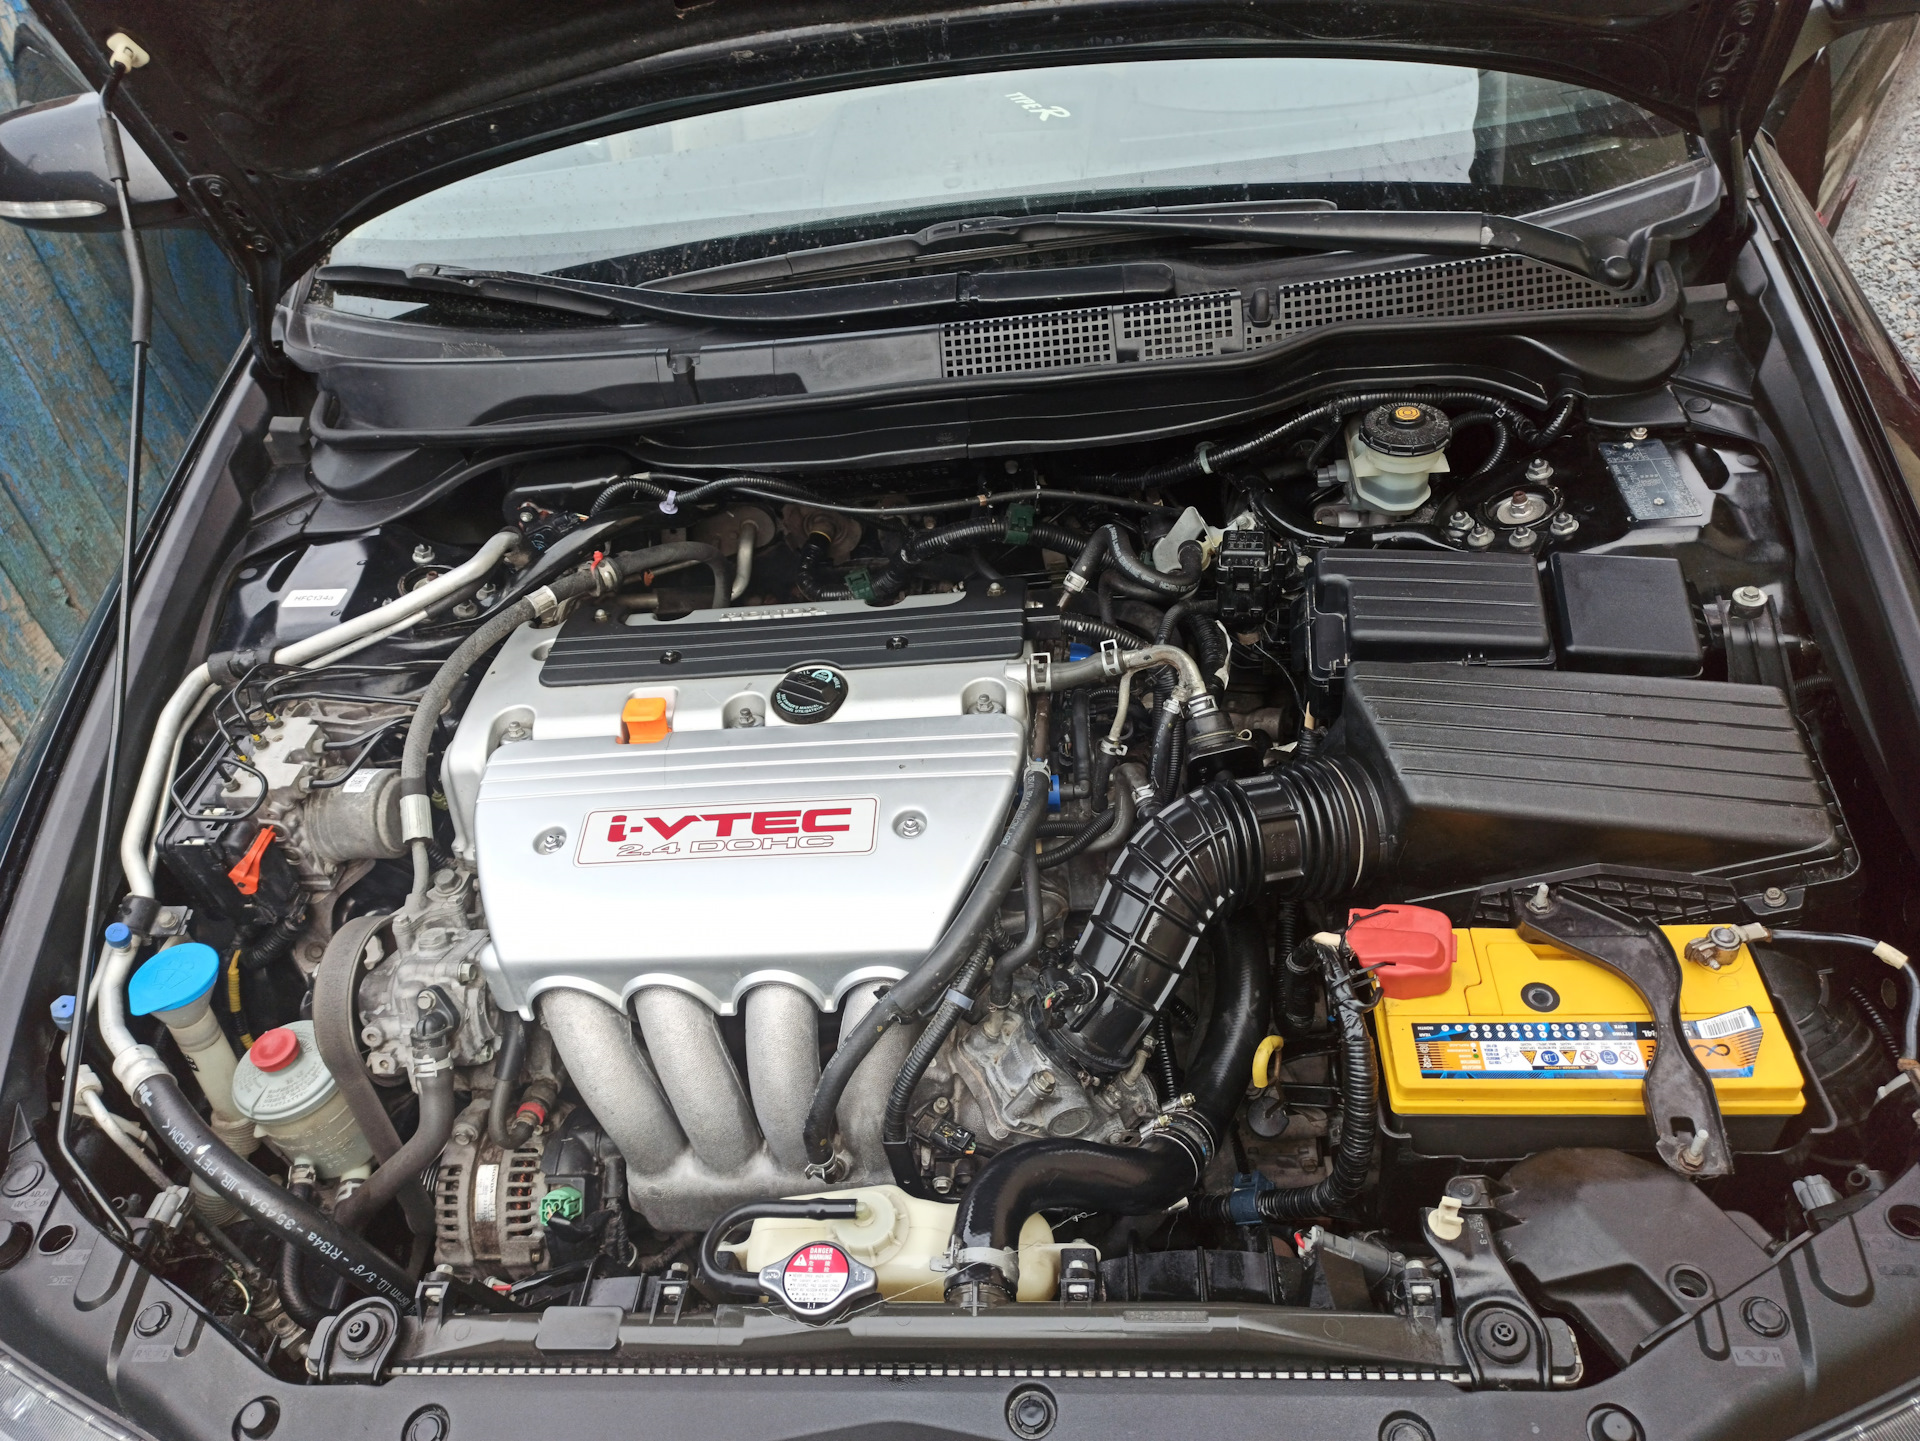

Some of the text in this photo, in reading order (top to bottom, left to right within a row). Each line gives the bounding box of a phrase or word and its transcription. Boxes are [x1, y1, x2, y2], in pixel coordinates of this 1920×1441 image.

[607, 807, 852, 843] i-VTEC
[616, 835, 835, 857] 2.4 DOHC
[827, 1041, 848, 1069] ENGINE
[167, 1126, 194, 1155] EPDM
[306, 1231, 343, 1261] R134a
[854, 1271, 867, 1281] 1.1
